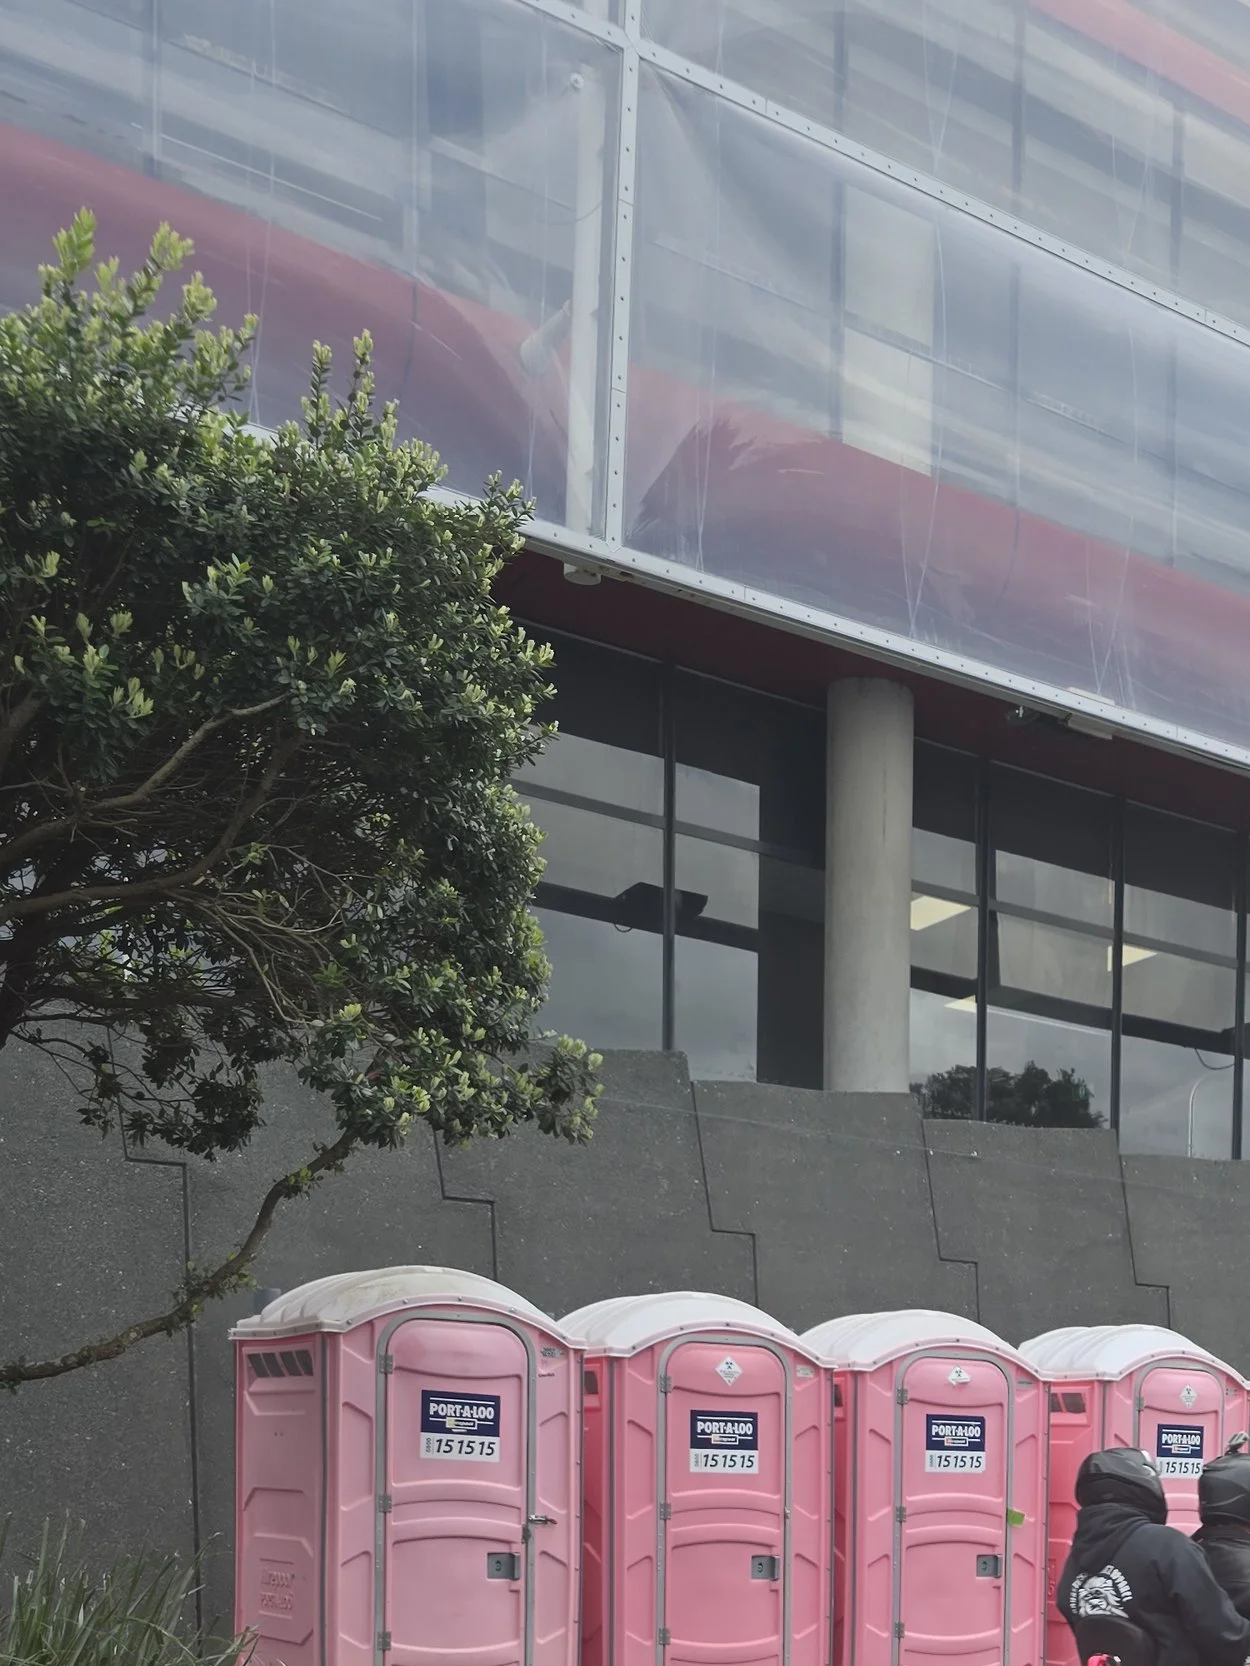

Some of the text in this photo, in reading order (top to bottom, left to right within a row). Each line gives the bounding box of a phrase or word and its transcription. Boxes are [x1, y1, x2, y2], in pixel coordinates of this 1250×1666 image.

[435, 1438, 496, 1456] 15 15 15
[703, 1454, 755, 1469] 15 15 15
[937, 1455, 951, 1468] 15
[953, 1455, 967, 1468] 15
[969, 1456, 982, 1469] 15
[1166, 1461, 1201, 1474] 15 15 15
